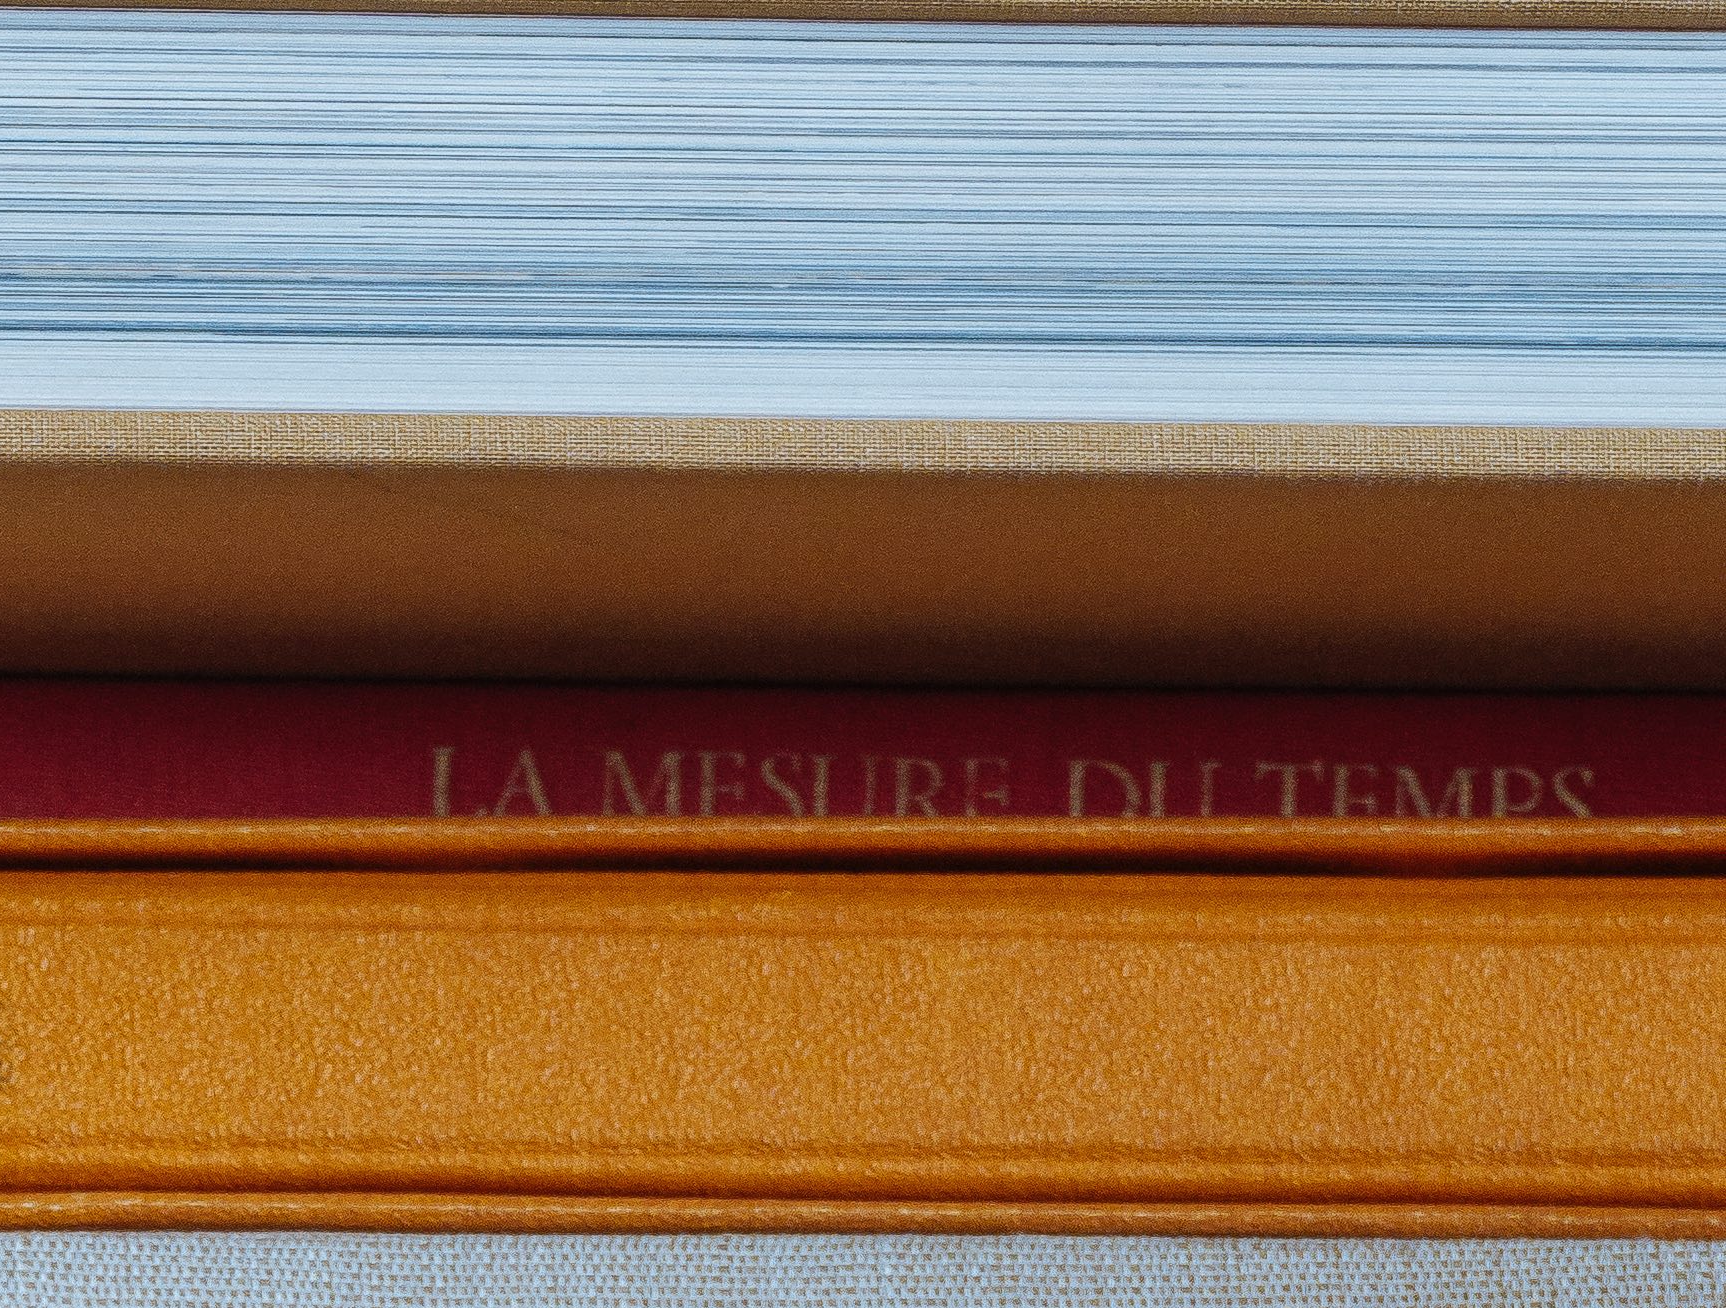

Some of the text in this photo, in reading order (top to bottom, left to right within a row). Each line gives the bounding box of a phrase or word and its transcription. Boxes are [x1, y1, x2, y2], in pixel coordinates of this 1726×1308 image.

[429, 744, 1597, 819] LA MESURE DU TEMPS
